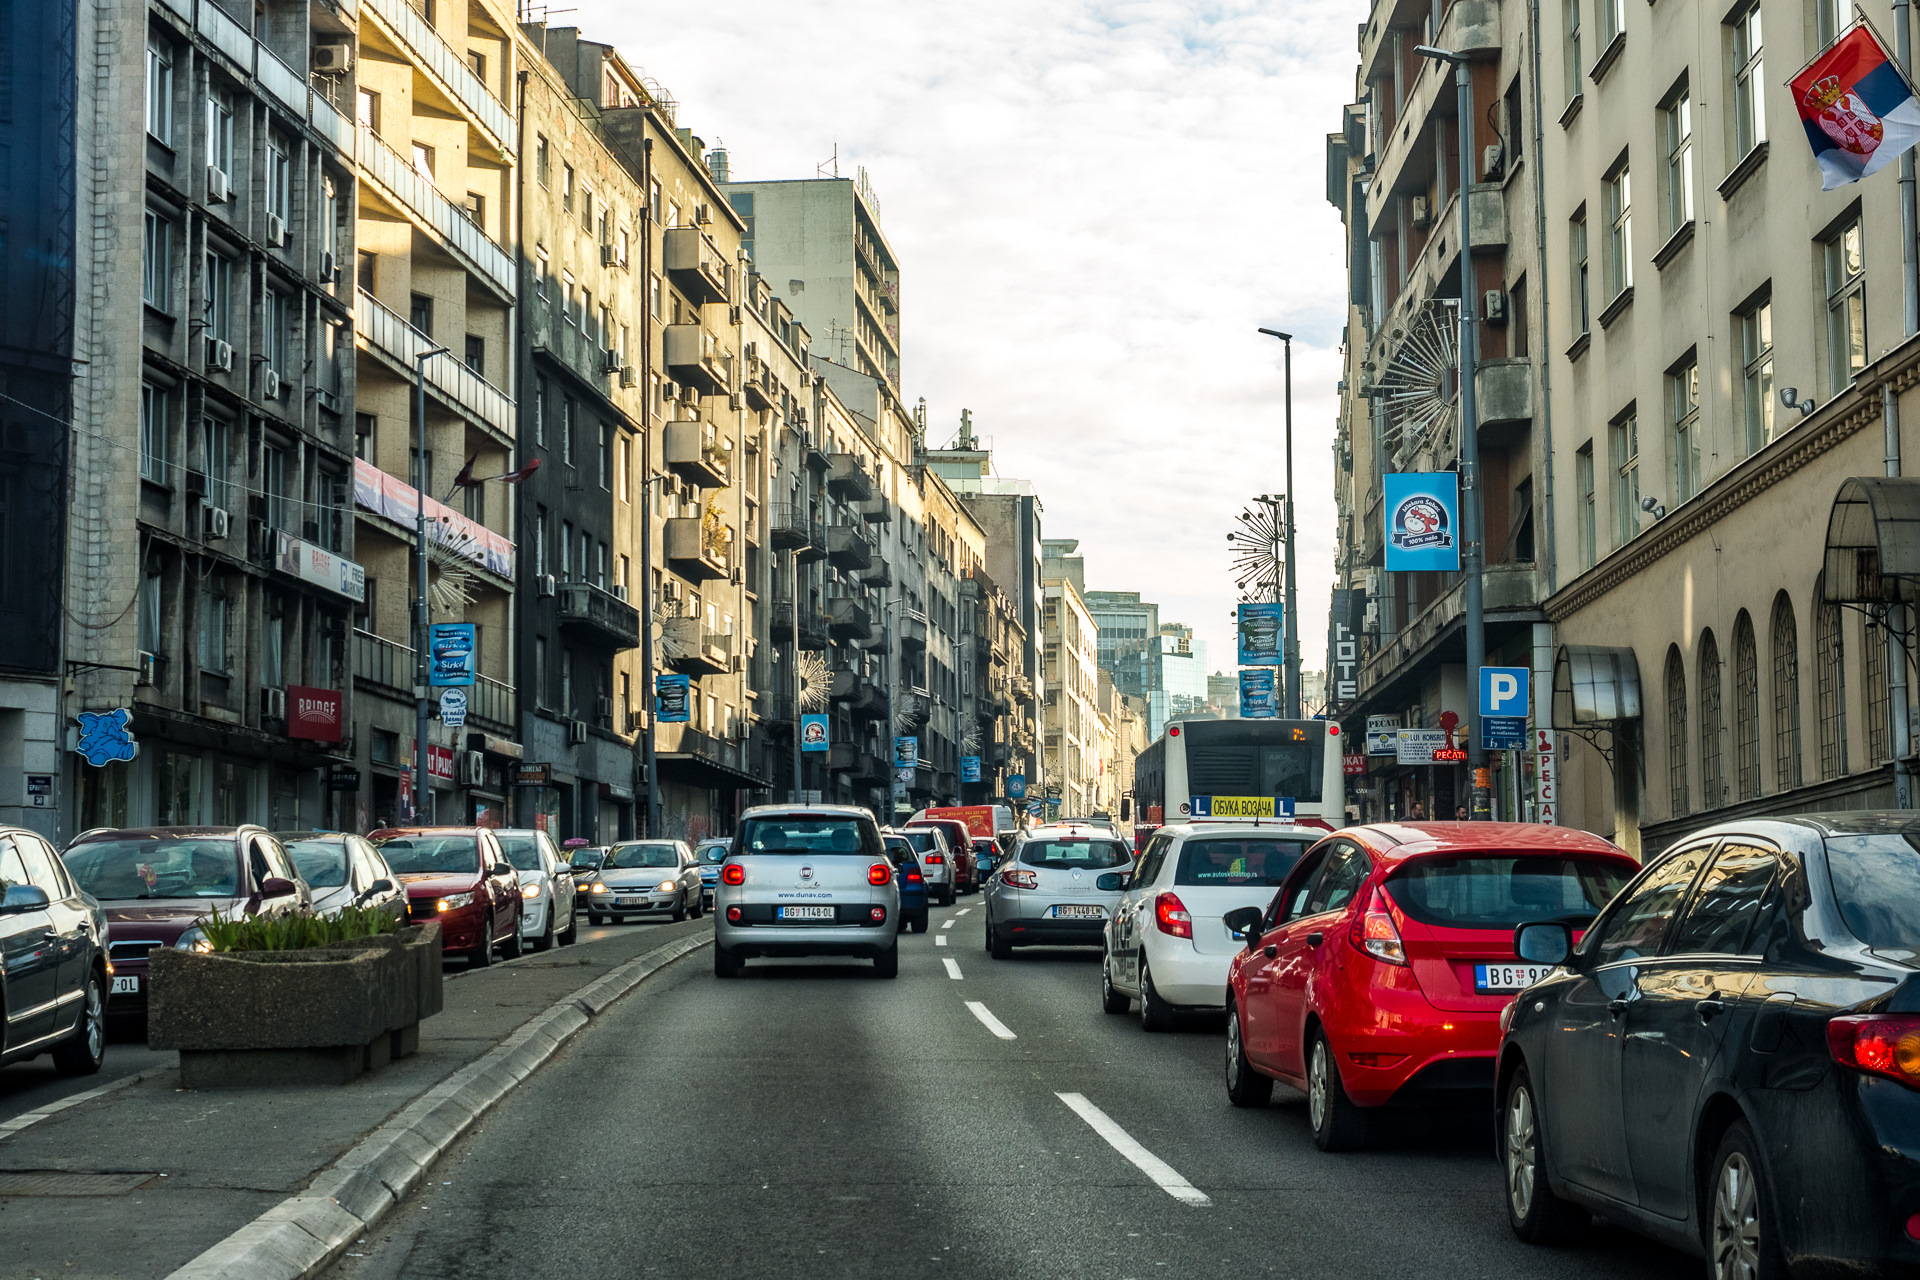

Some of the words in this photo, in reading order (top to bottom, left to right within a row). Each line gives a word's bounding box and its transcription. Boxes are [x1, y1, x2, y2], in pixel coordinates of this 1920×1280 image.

[1402, 499, 1424, 513] Mlekara
[1425, 499, 1441, 513] Šabac
[1408, 537, 1424, 545] 100%
[352, 567, 364, 585] FREE
[1336, 622, 1356, 707] HOTE
[1491, 674, 1518, 710] P
[299, 697, 335, 716] BRIDGE
[1368, 717, 1400, 728] PEČATI
[1436, 749, 1465, 759] PEČATI
[438, 756, 453, 775] PLUS
[1195, 798, 1207, 815] L
[1213, 800, 1240, 815] ОБУКА
[1241, 800, 1272, 816] ВОЗАЧА
[1279, 800, 1290, 816] L
[1197, 871, 1258, 879] www.autoskolastop.rs
[784, 907, 795, 917] BG
[801, 907, 833, 917] 1148-OL
[1058, 906, 1068, 915] BG
[1490, 968, 1513, 985] BG
